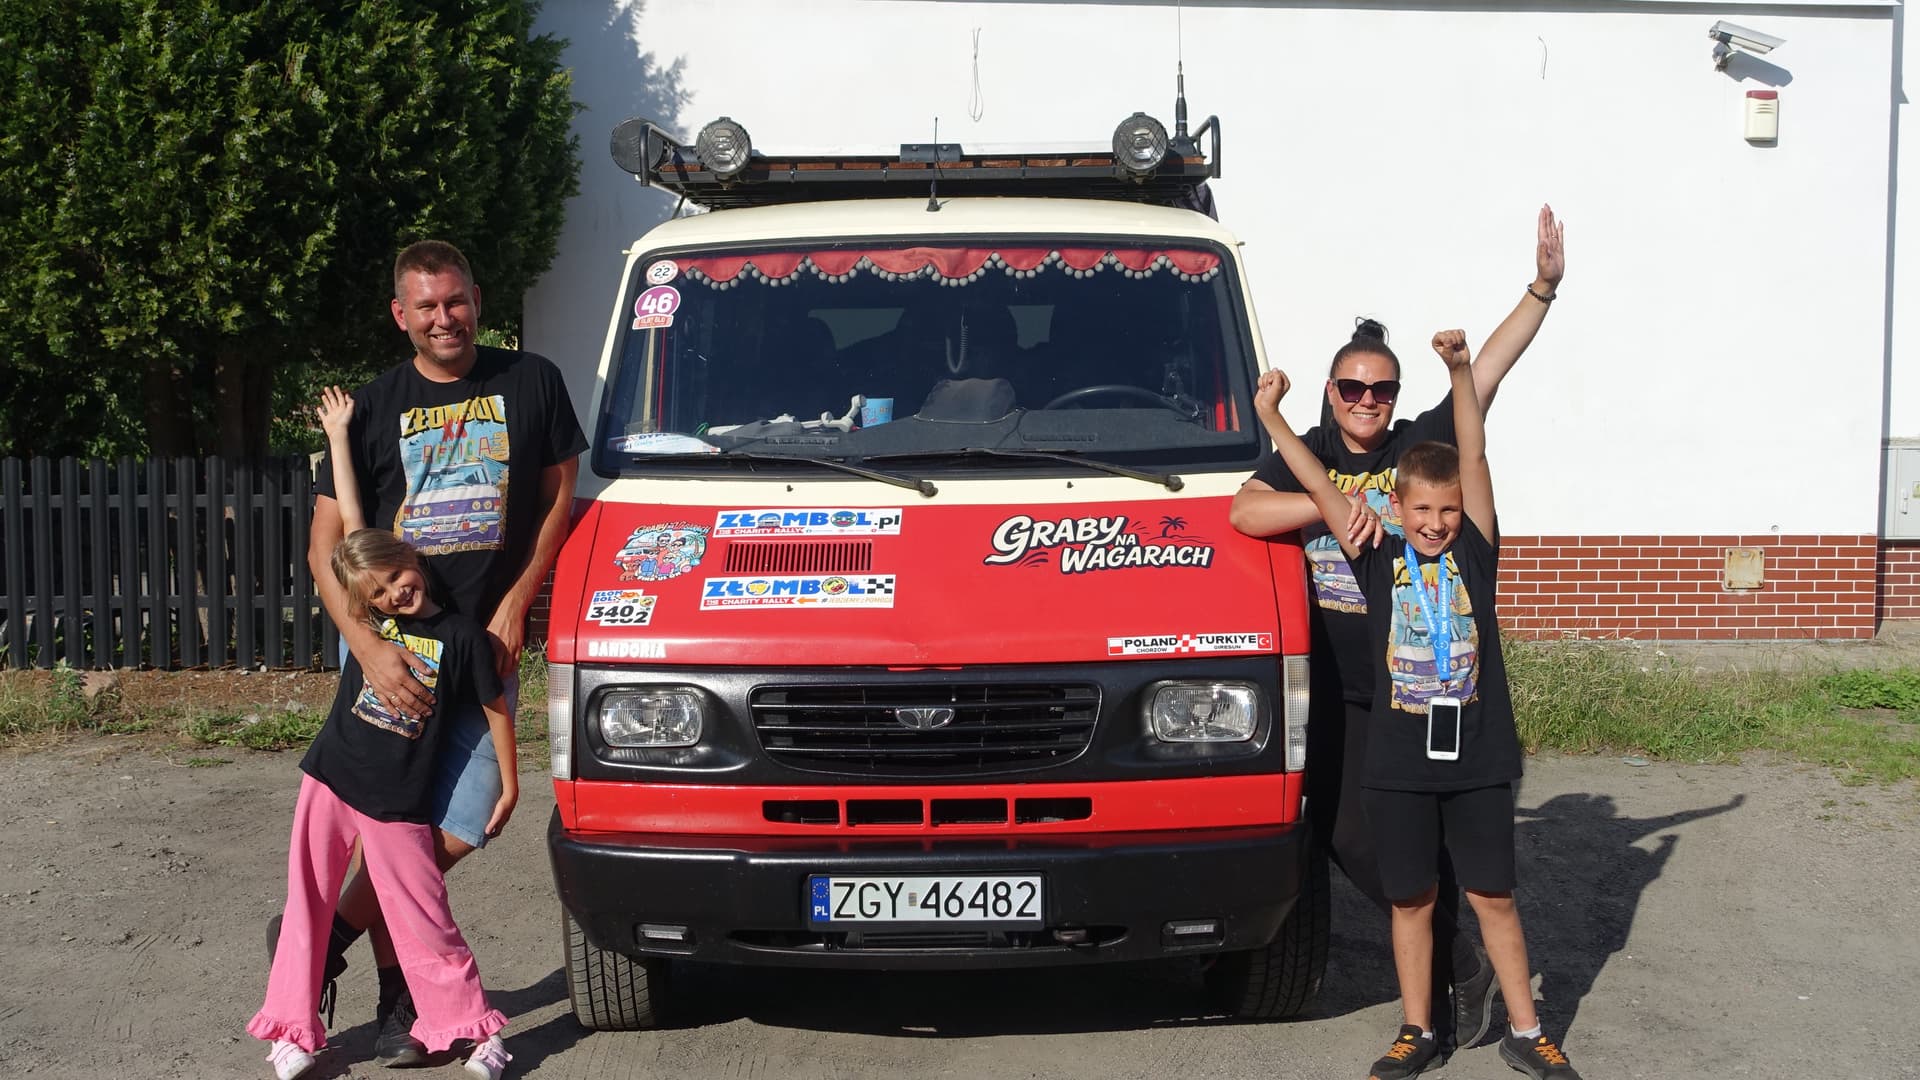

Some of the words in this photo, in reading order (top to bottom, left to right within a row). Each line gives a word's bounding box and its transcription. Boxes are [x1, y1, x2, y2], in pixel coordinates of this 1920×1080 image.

[654, 267, 671, 277] 22
[641, 292, 674, 314] 46
[983, 515, 1126, 564] GRABY
[1115, 534, 1137, 547] NA
[1061, 544, 1212, 573] WAGARACH
[1124, 637, 1178, 648] POLAND
[1197, 635, 1257, 645] TURKIYE
[815, 906, 828, 917] PL
[833, 882, 905, 919] ZGY
[919, 880, 1038, 918] 46482
